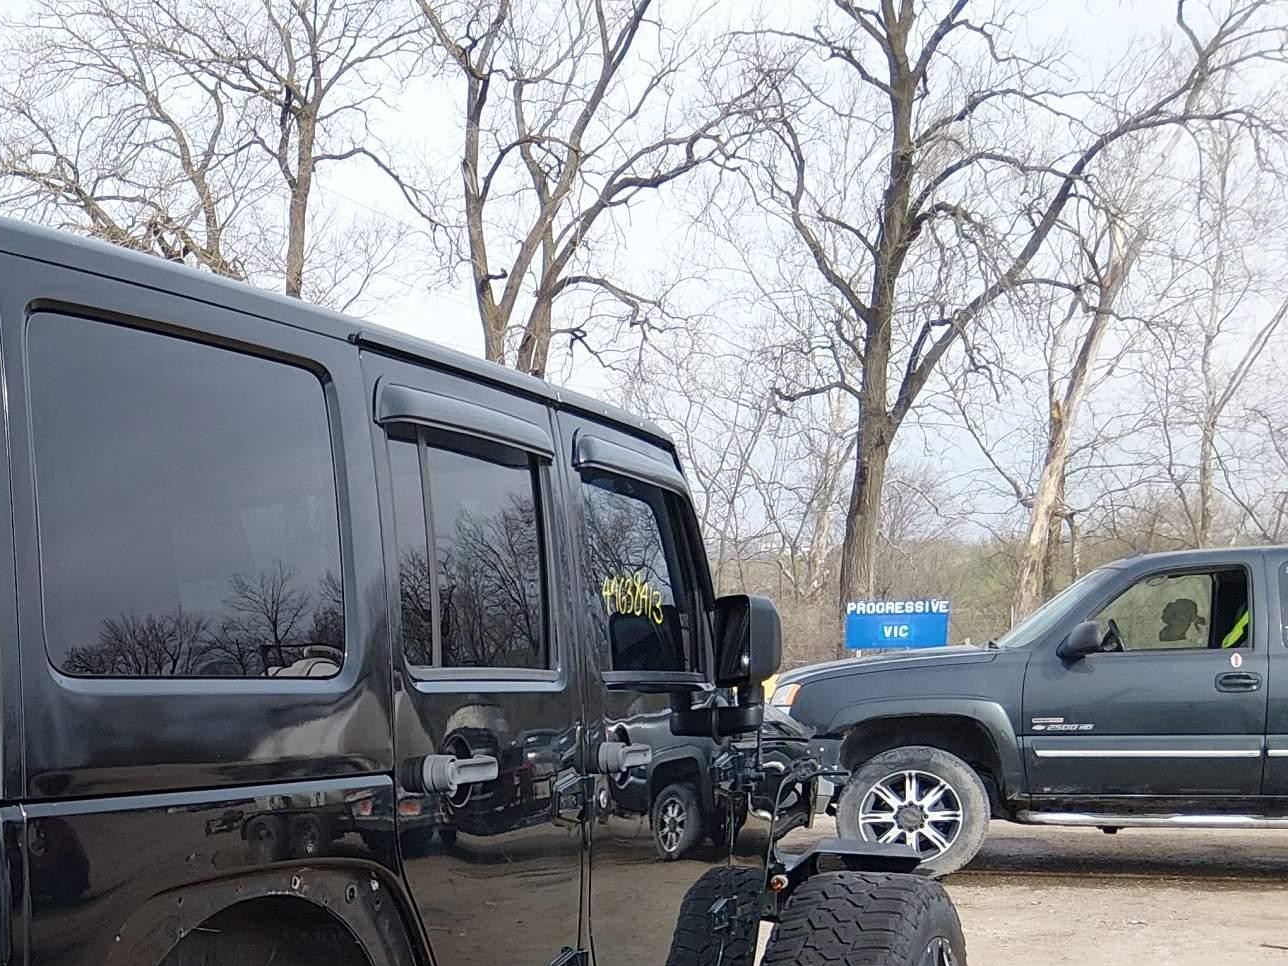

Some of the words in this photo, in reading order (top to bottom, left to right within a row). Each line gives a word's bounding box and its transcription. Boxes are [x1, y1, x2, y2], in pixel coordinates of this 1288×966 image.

[602, 570, 663, 624] 44638413
[847, 600, 949, 614] PROGRESSIVE
[883, 625, 909, 638] VIC
